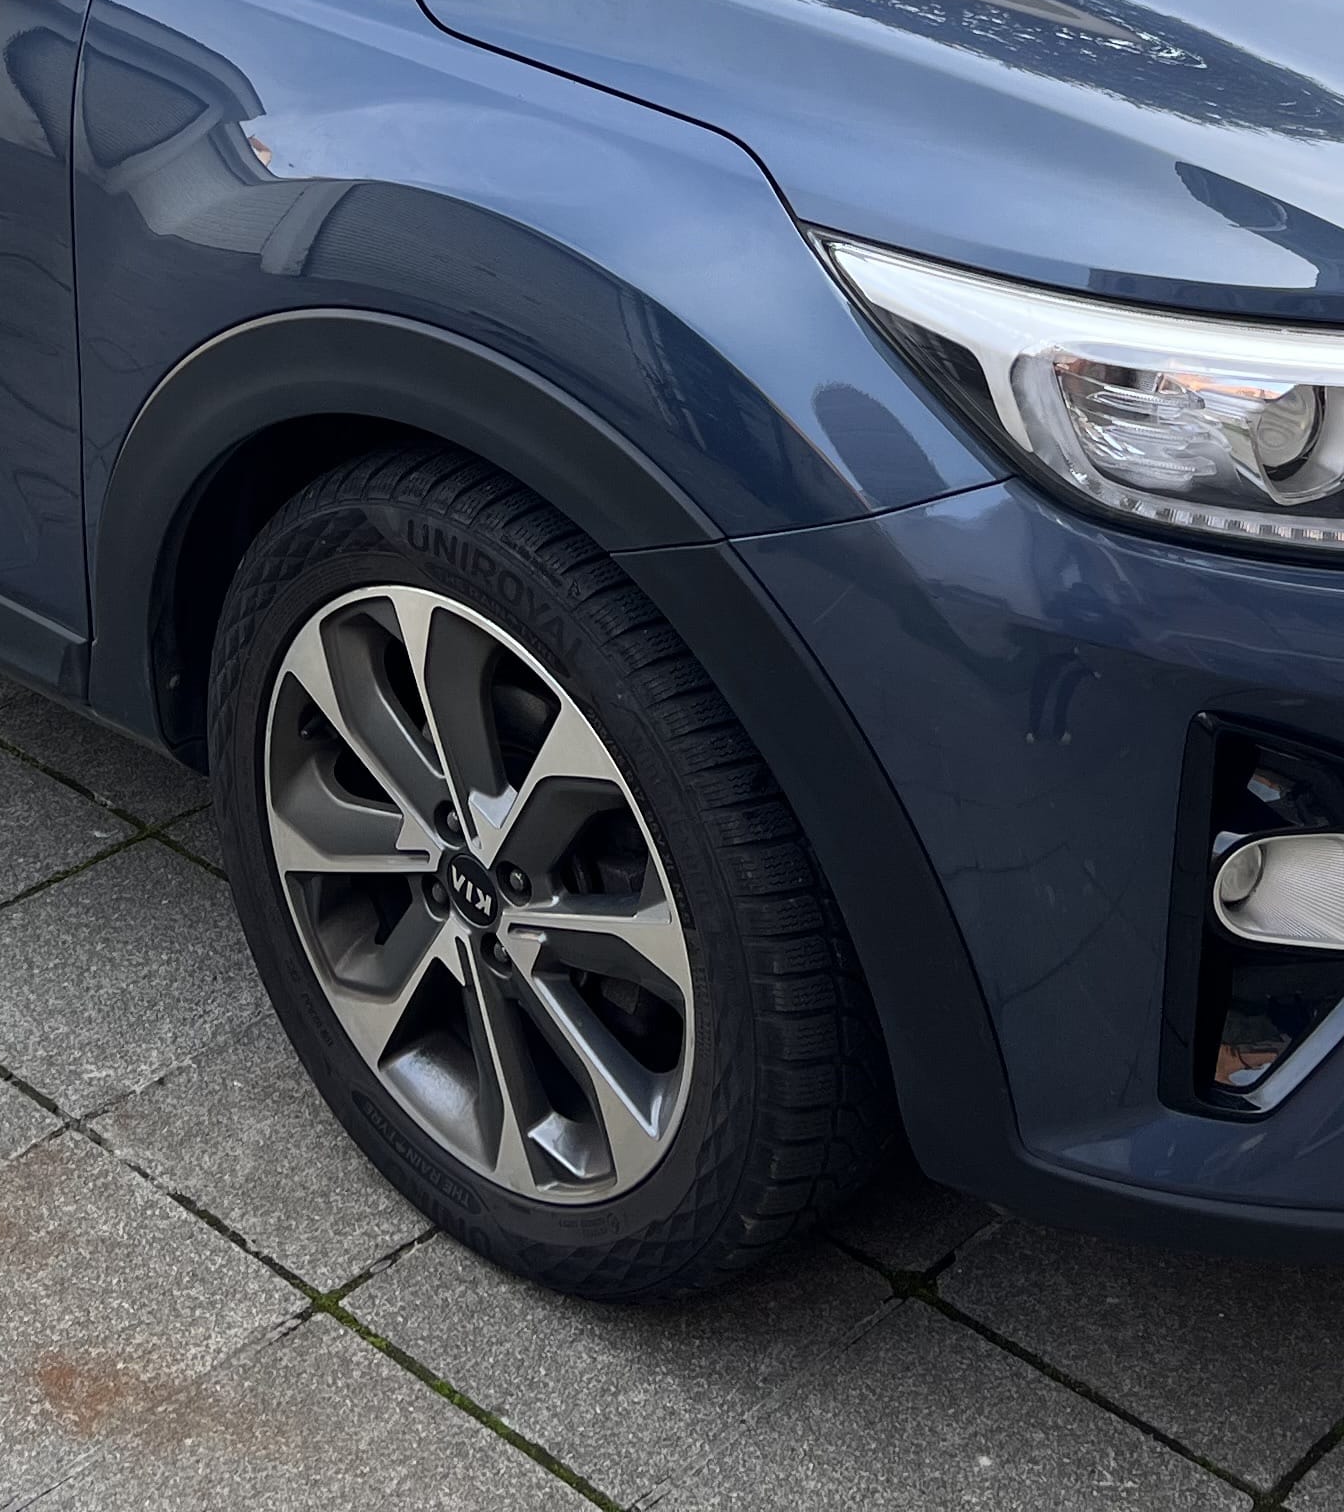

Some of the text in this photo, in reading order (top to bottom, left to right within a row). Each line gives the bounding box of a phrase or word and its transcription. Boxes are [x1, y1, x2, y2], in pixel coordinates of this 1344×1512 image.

[407, 519, 583, 664] UNIROYAL
[452, 864, 492, 916] KIA
[363, 1102, 471, 1208] THE RAIN TYRE
